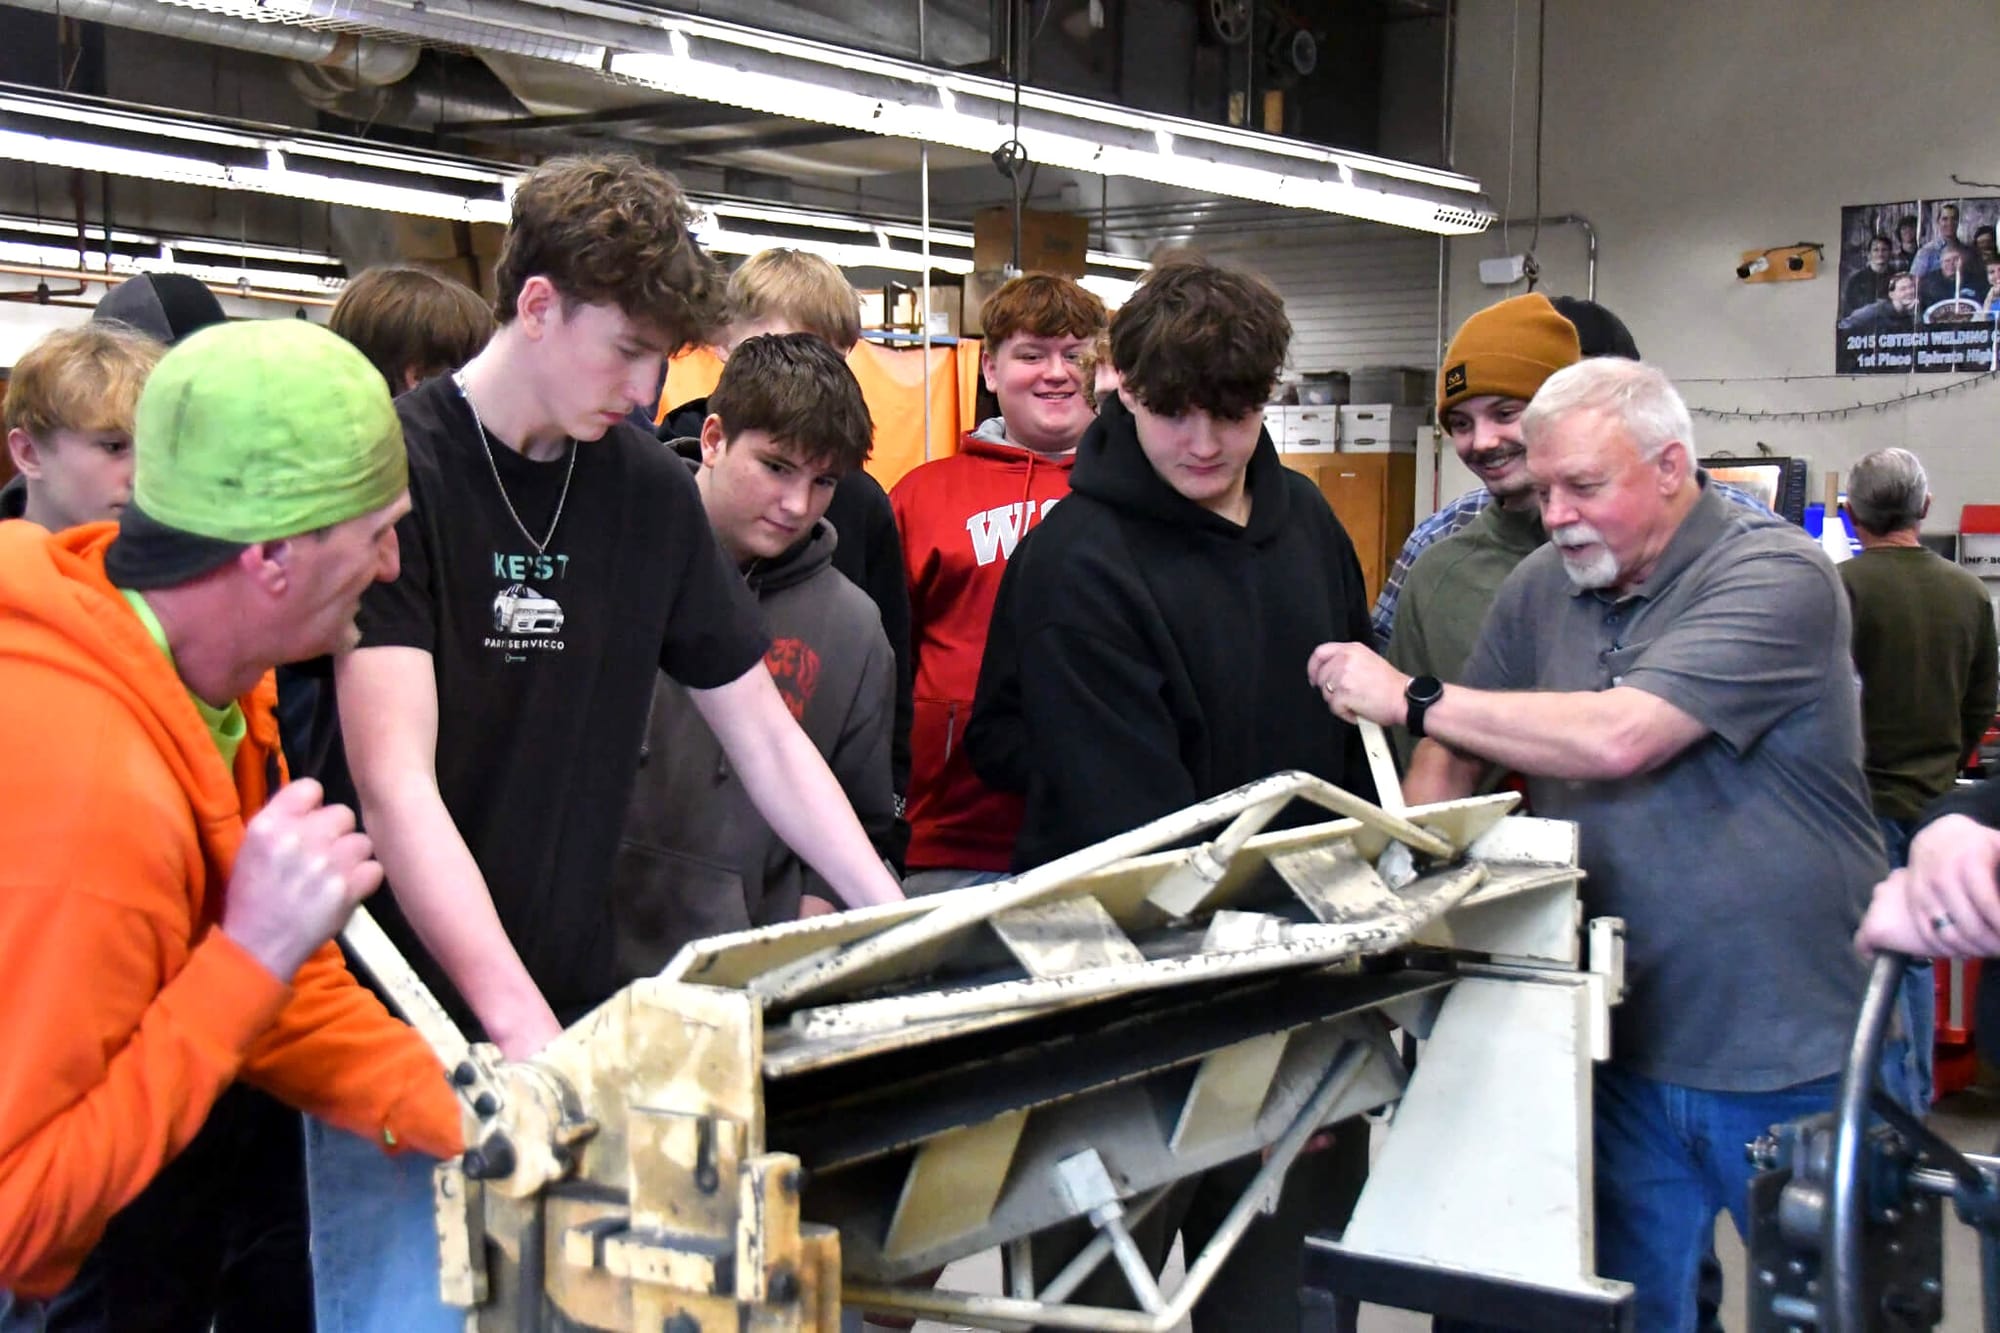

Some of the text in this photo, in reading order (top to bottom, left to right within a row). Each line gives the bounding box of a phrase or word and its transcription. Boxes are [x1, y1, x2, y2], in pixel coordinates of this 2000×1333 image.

[1847, 335, 1876, 350] 2015
[1931, 330, 1988, 345] WELDING
[1878, 352, 1912, 366] Place
